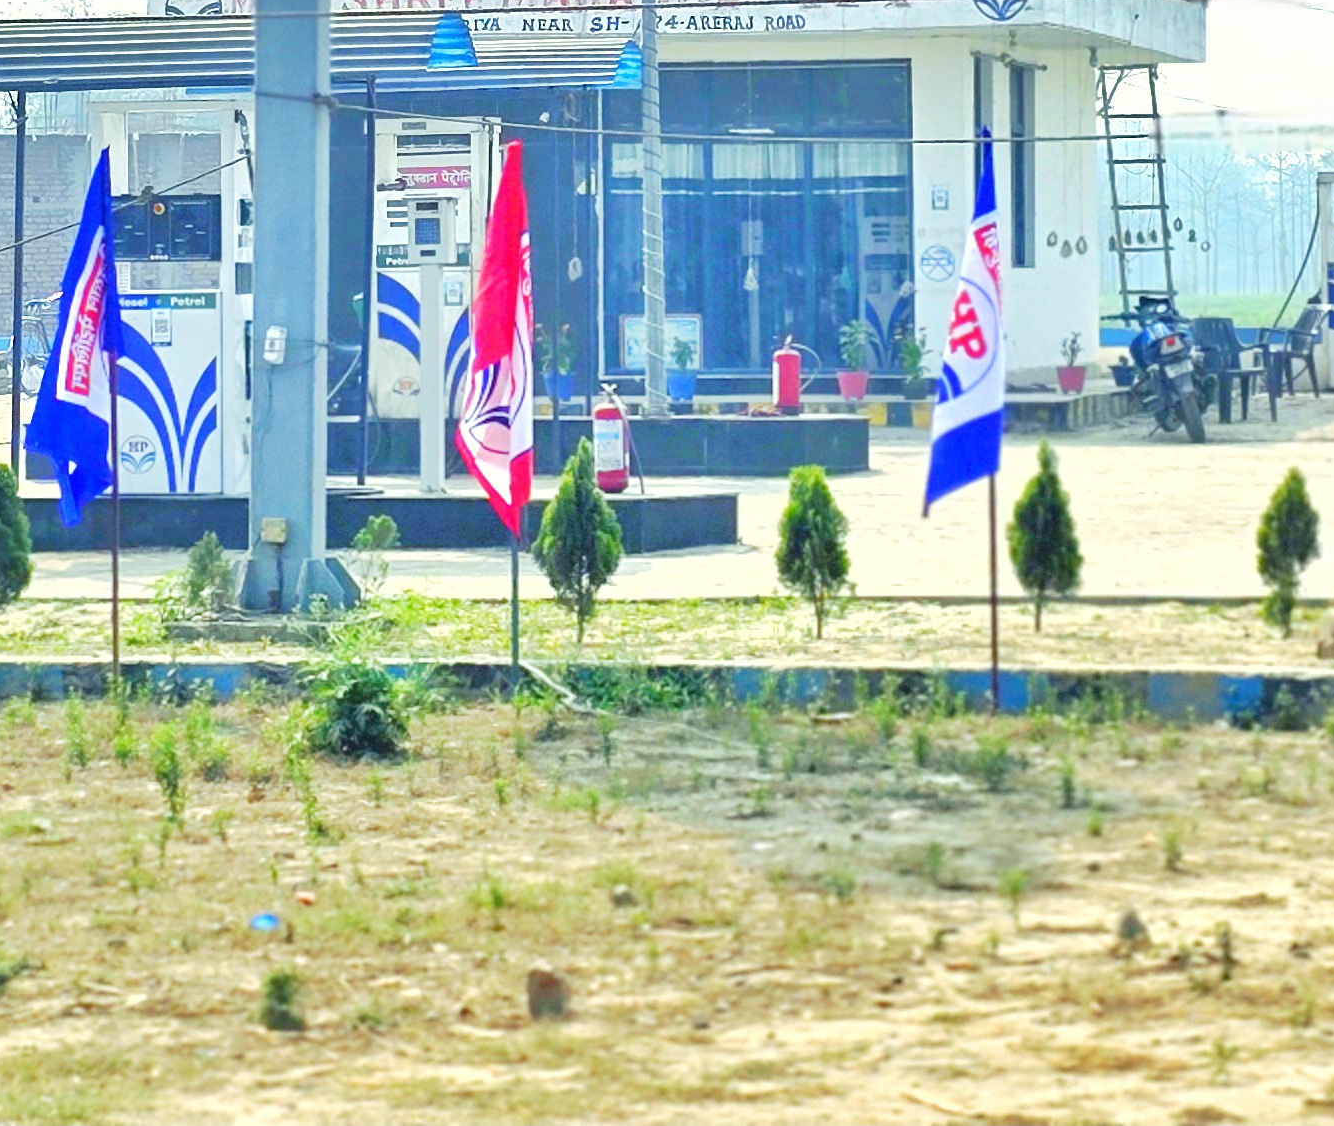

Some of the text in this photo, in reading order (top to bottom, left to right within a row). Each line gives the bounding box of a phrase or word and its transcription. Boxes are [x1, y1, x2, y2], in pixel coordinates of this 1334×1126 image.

[522, 18, 574, 32] NEAR
[763, 14, 807, 31] ROAD
[170, 296, 206, 307] Petrol
[128, 441, 149, 453] HP
